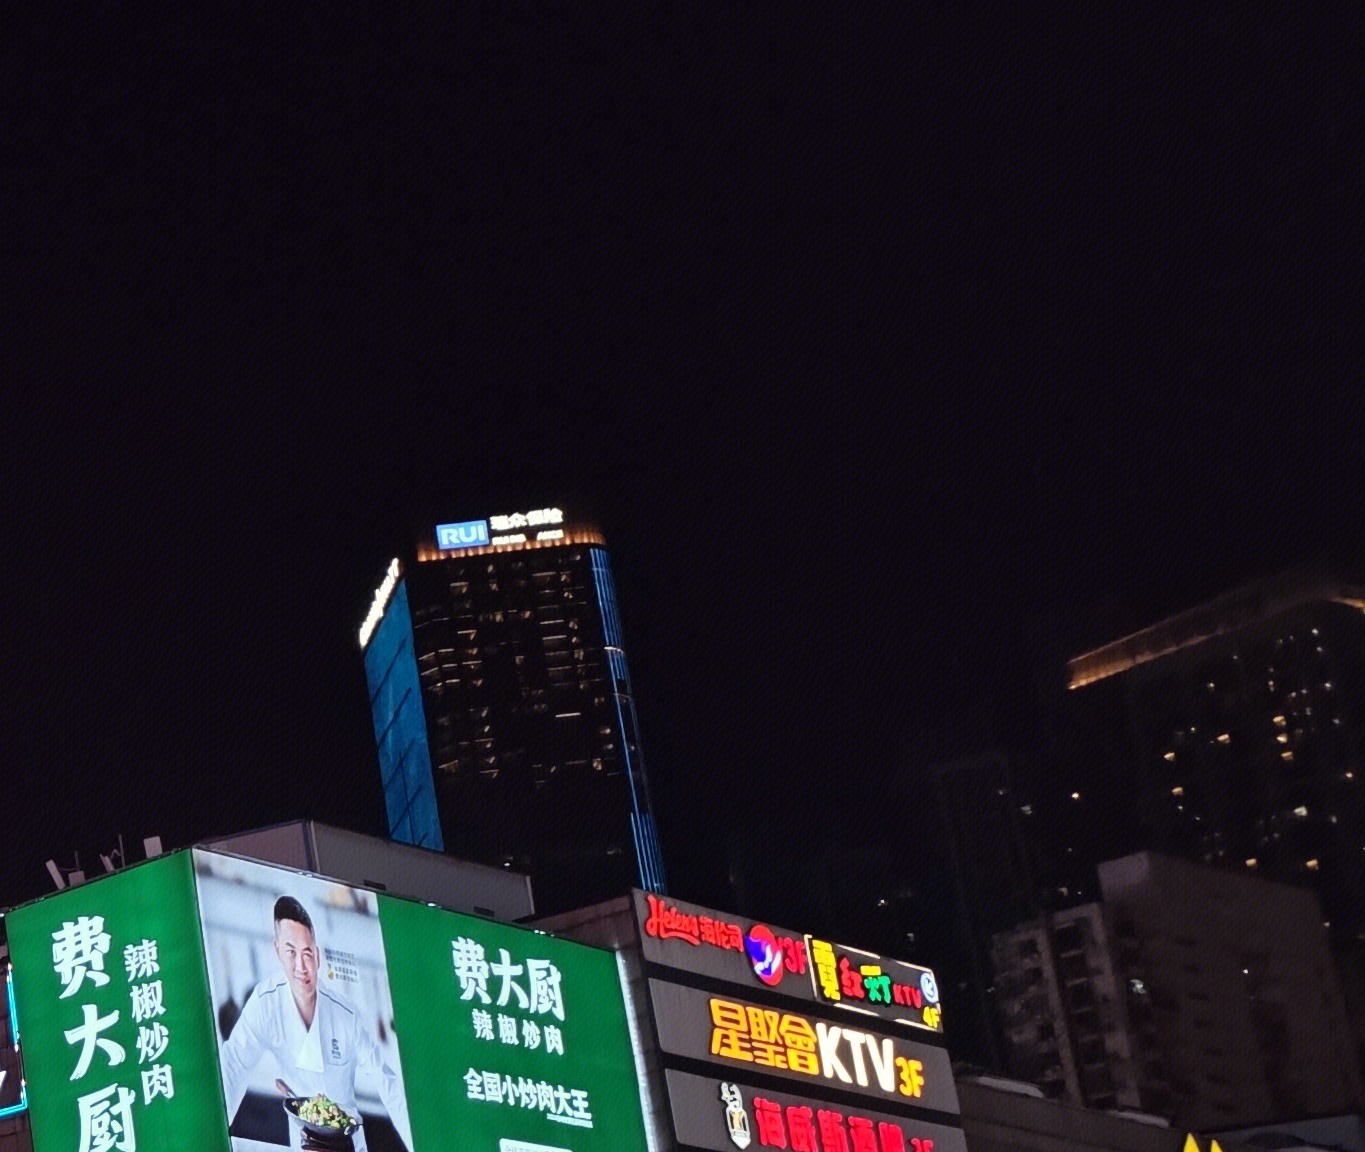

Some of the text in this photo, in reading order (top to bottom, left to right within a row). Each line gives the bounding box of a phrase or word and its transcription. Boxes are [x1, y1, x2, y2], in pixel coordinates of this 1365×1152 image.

[440, 524, 487, 545] RUI
[451, 936, 565, 1021] 费大厨
[785, 937, 809, 975] 3F
[123, 938, 175, 1106] 辣椒炒肉
[893, 984, 922, 1009] KTV
[471, 1008, 565, 1056] 辣椒炒肉
[816, 1022, 895, 1093] KTV
[895, 1056, 925, 1098] 3F
[463, 1067, 592, 1121] 全国小炒肉大王
